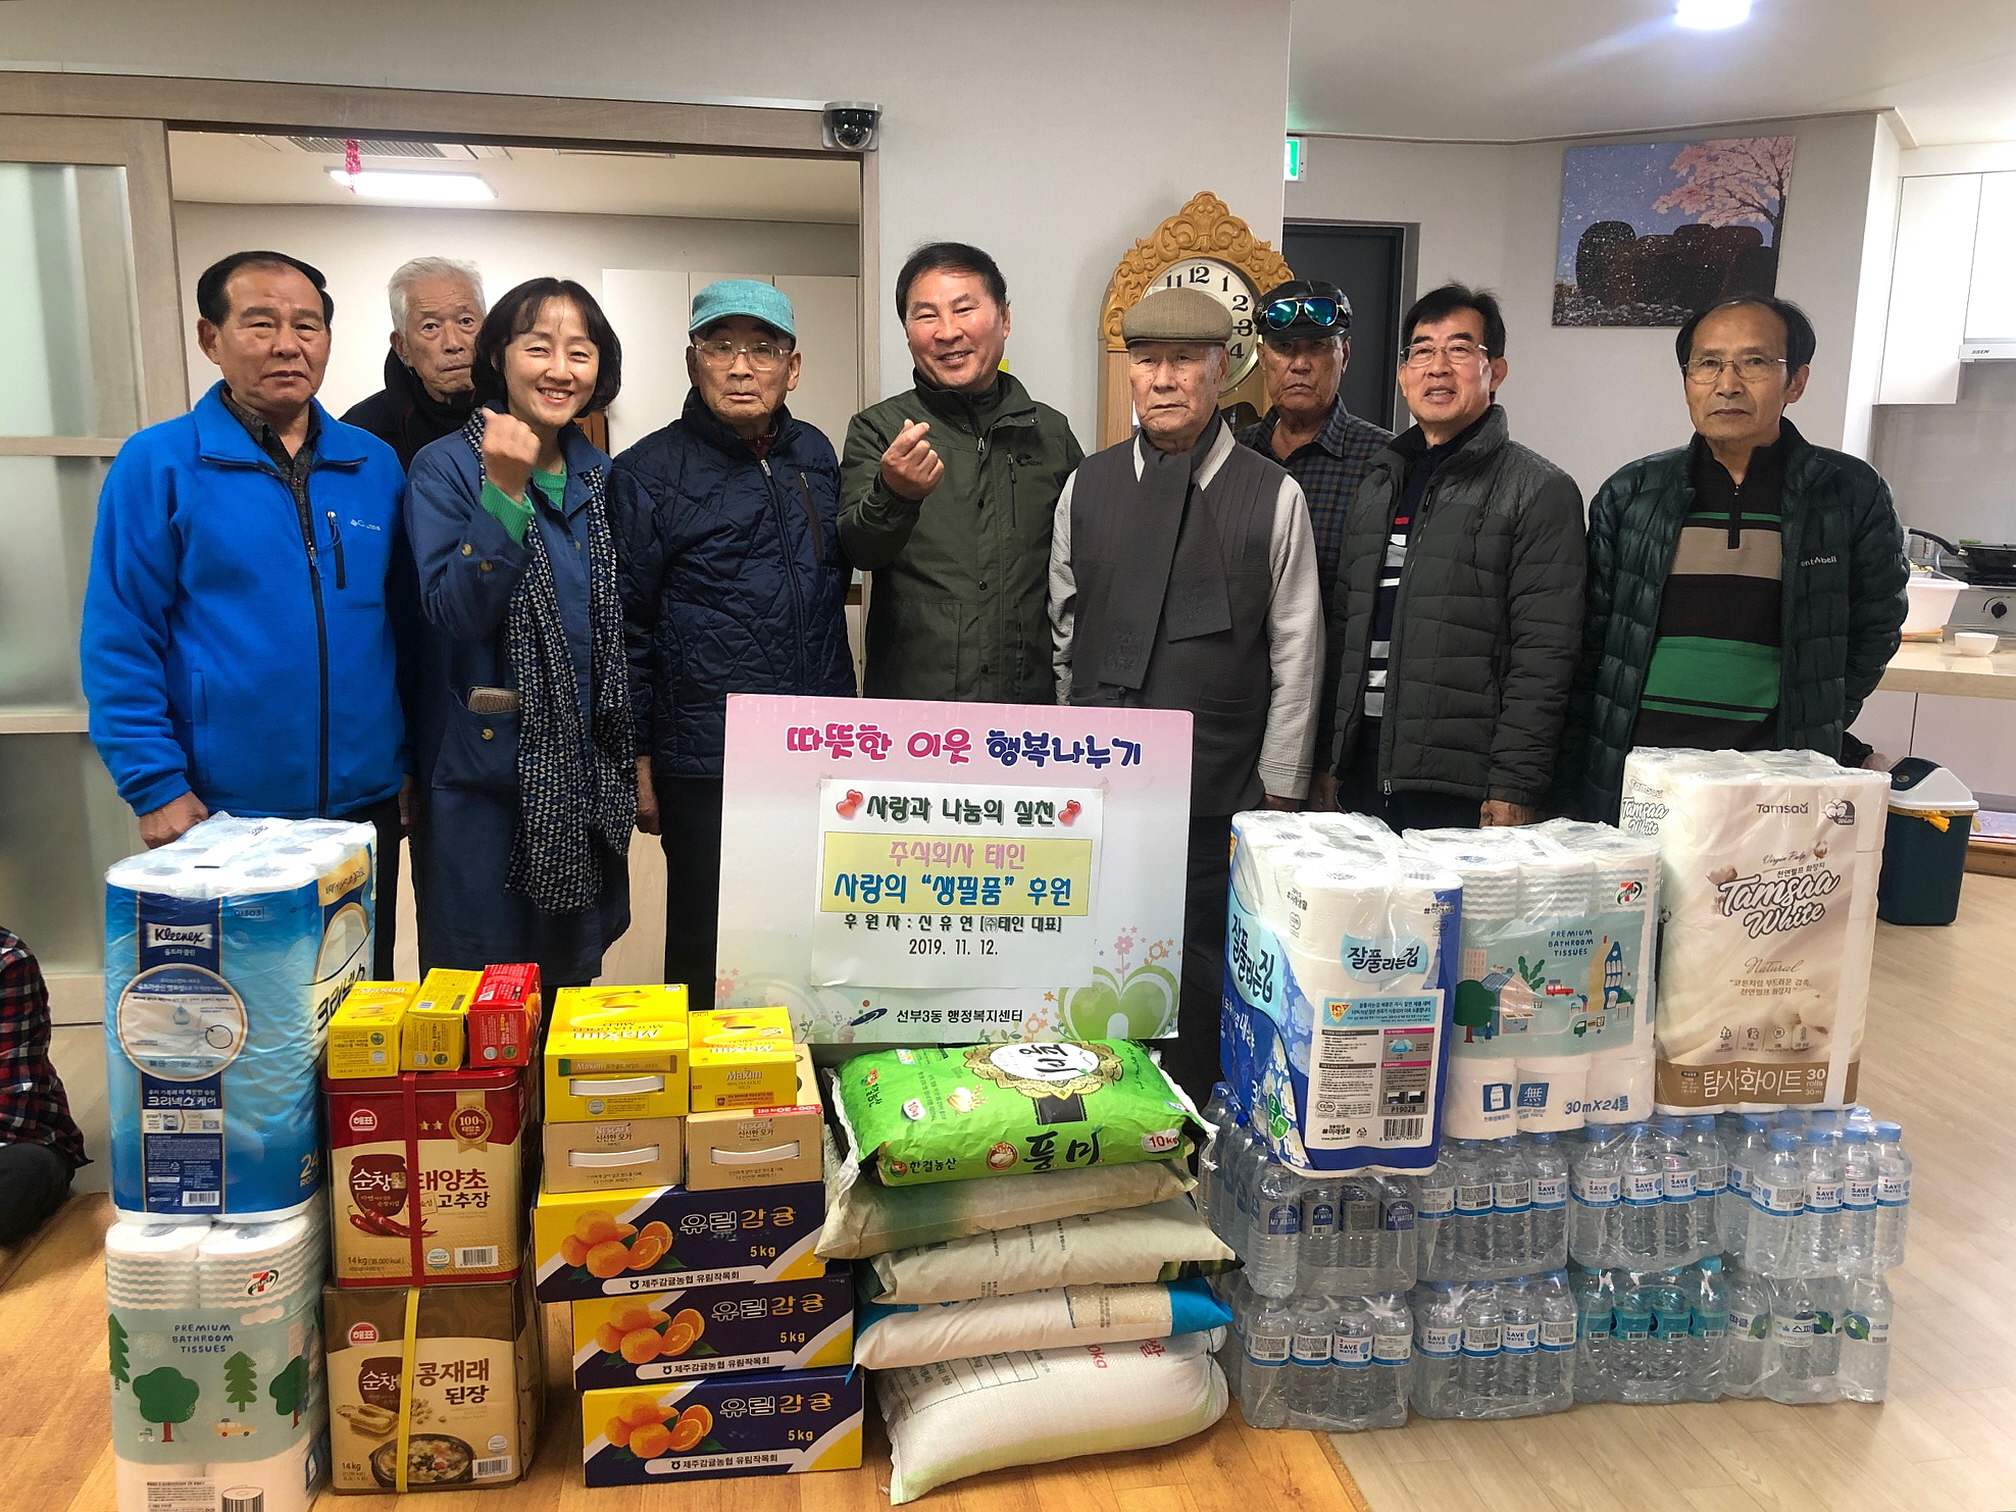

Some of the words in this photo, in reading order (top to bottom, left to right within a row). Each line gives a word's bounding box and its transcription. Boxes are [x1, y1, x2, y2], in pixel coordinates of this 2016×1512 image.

[1166, 274, 1182, 287] 11
[1189, 266, 1210, 284] 12
[1222, 275, 1228, 292] 1
[1232, 295, 1248, 311] 2
[1237, 319, 1253, 336] 3
[1230, 343, 1244, 358] 4
[786, 723, 893, 761] 따뜻한
[907, 728, 971, 764] 이웃
[986, 730, 1142, 769] 행복나누기
[867, 795, 931, 823] 사랑과
[942, 797, 1003, 825] 나눔의
[1014, 800, 1056, 827] 실천
[889, 841, 974, 868] 주식회사
[985, 844, 1026, 869] 태인
[1763, 853, 1787, 866] Virgin
[1806, 862, 1825, 872] 화장지
[835, 873, 907, 904] 사랑의
[1027, 877, 1071, 906] 후원
[1719, 871, 1841, 917] Tamsaa
[1744, 902, 1826, 939] White
[154, 927, 206, 944] Kleenex
[1550, 929, 1593, 938] PREMIUM
[909, 938, 946, 955] 2019.
[955, 939, 970, 955] 11.
[980, 939, 998, 955] 12.
[1548, 939, 1594, 948] BATHROOM
[1231, 913, 1275, 1004] 잘풀리는집
[1347, 945, 1420, 974] 잘풀리는집
[1554, 948, 1588, 957] TISSUES
[1744, 955, 1804, 975] Natural
[896, 1009, 942, 1024] 선부3동
[948, 1009, 1023, 1024] 행정복지센터
[573, 1030, 659, 1042] Maxim
[727, 1067, 763, 1081] Maxim
[1703, 1067, 1802, 1098] 탐사화이트
[1806, 1069, 1826, 1080] 30
[147, 1096, 195, 1107] 크리넥스
[197, 1096, 216, 1106] 케어
[353, 1116, 374, 1125] 해표
[596, 1134, 617, 1142] 신선한
[619, 1133, 632, 1141] 모카
[738, 1129, 759, 1138] 신선한
[1149, 1135, 1178, 1149] 10kg
[908, 1157, 957, 1174] 한결농산
[352, 1168, 392, 1191] 순창
[418, 1168, 489, 1192] 태양초
[438, 1191, 491, 1209] 고추장
[641, 1275, 694, 1288] 제주감귤농협
[696, 1270, 740, 1283] 유림작목회
[174, 1324, 231, 1332] PREMIUM
[352, 1330, 375, 1340] 해표
[172, 1334, 234, 1343] BATHROOM
[180, 1345, 227, 1353] TISSUES
[674, 1360, 725, 1373] 제주감귤농협
[728, 1356, 770, 1368] 유림작목회
[362, 1371, 397, 1391] 순창
[415, 1357, 490, 1387] 콩재래
[445, 1384, 490, 1405] 된장
[682, 1456, 733, 1468] 제주감귤농협
[736, 1453, 778, 1465] 유림작목회
